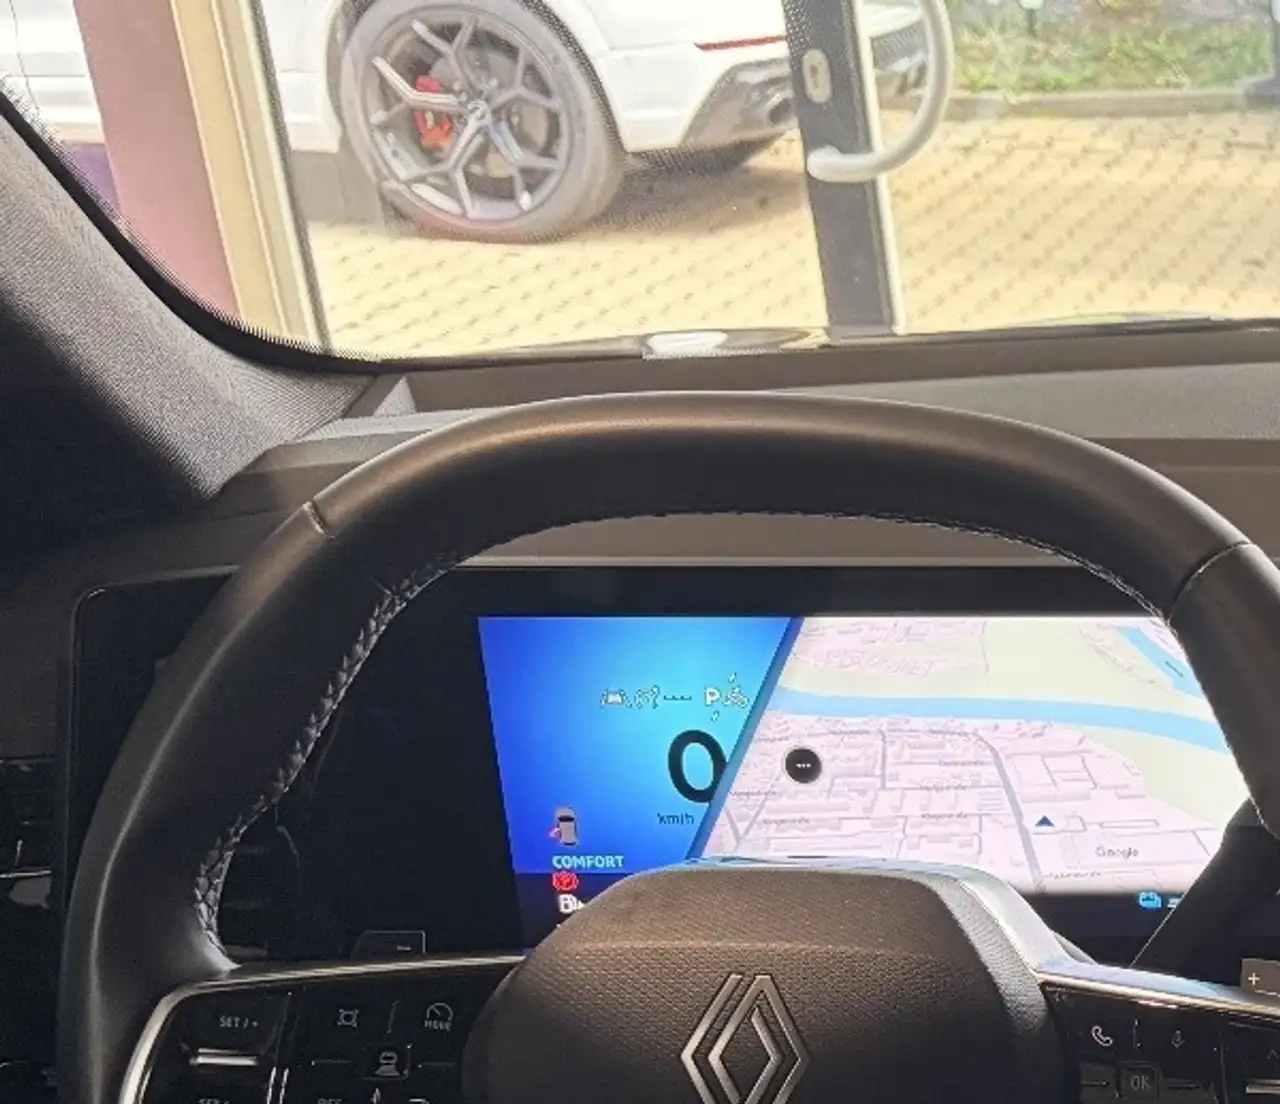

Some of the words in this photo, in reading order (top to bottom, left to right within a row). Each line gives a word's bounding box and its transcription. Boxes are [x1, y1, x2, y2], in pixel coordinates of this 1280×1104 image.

[668, 729, 727, 803] 0
[552, 855, 625, 869] COMFORT
[1130, 1075, 1150, 1091] OK
